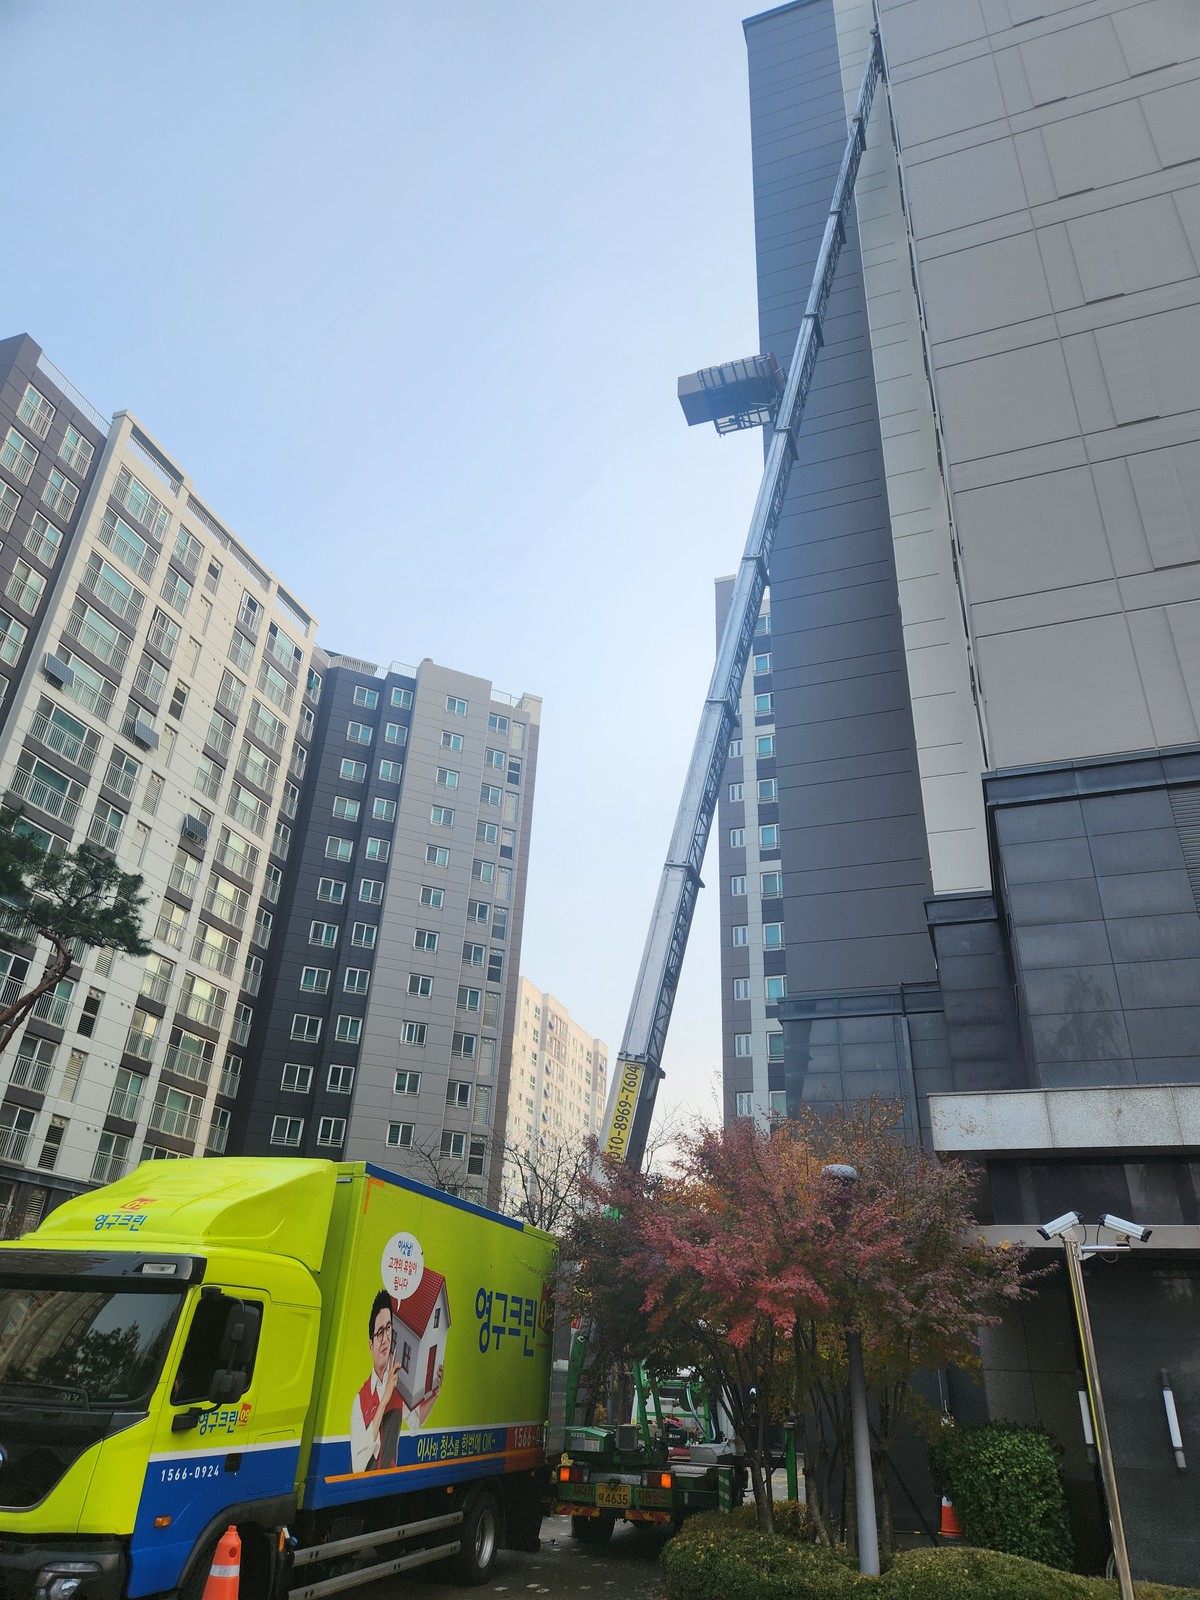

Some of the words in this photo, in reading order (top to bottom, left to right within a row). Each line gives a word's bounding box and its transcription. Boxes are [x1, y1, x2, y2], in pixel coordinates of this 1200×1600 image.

[607, 1063, 641, 1160] 010-8969-7604
[94, 1214, 148, 1231] 영구크린
[388, 1257, 403, 1272] 고객의
[403, 1260, 418, 1276] 휴일이
[393, 1276, 409, 1291] 됩니다
[475, 1287, 538, 1357] 영구크린
[198, 1410, 239, 1436] 영구크린
[417, 1437, 438, 1461] 이사와
[440, 1434, 460, 1459] 청소를
[461, 1432, 481, 1456] 한번에
[161, 1464, 220, 1482] 1566-0924
